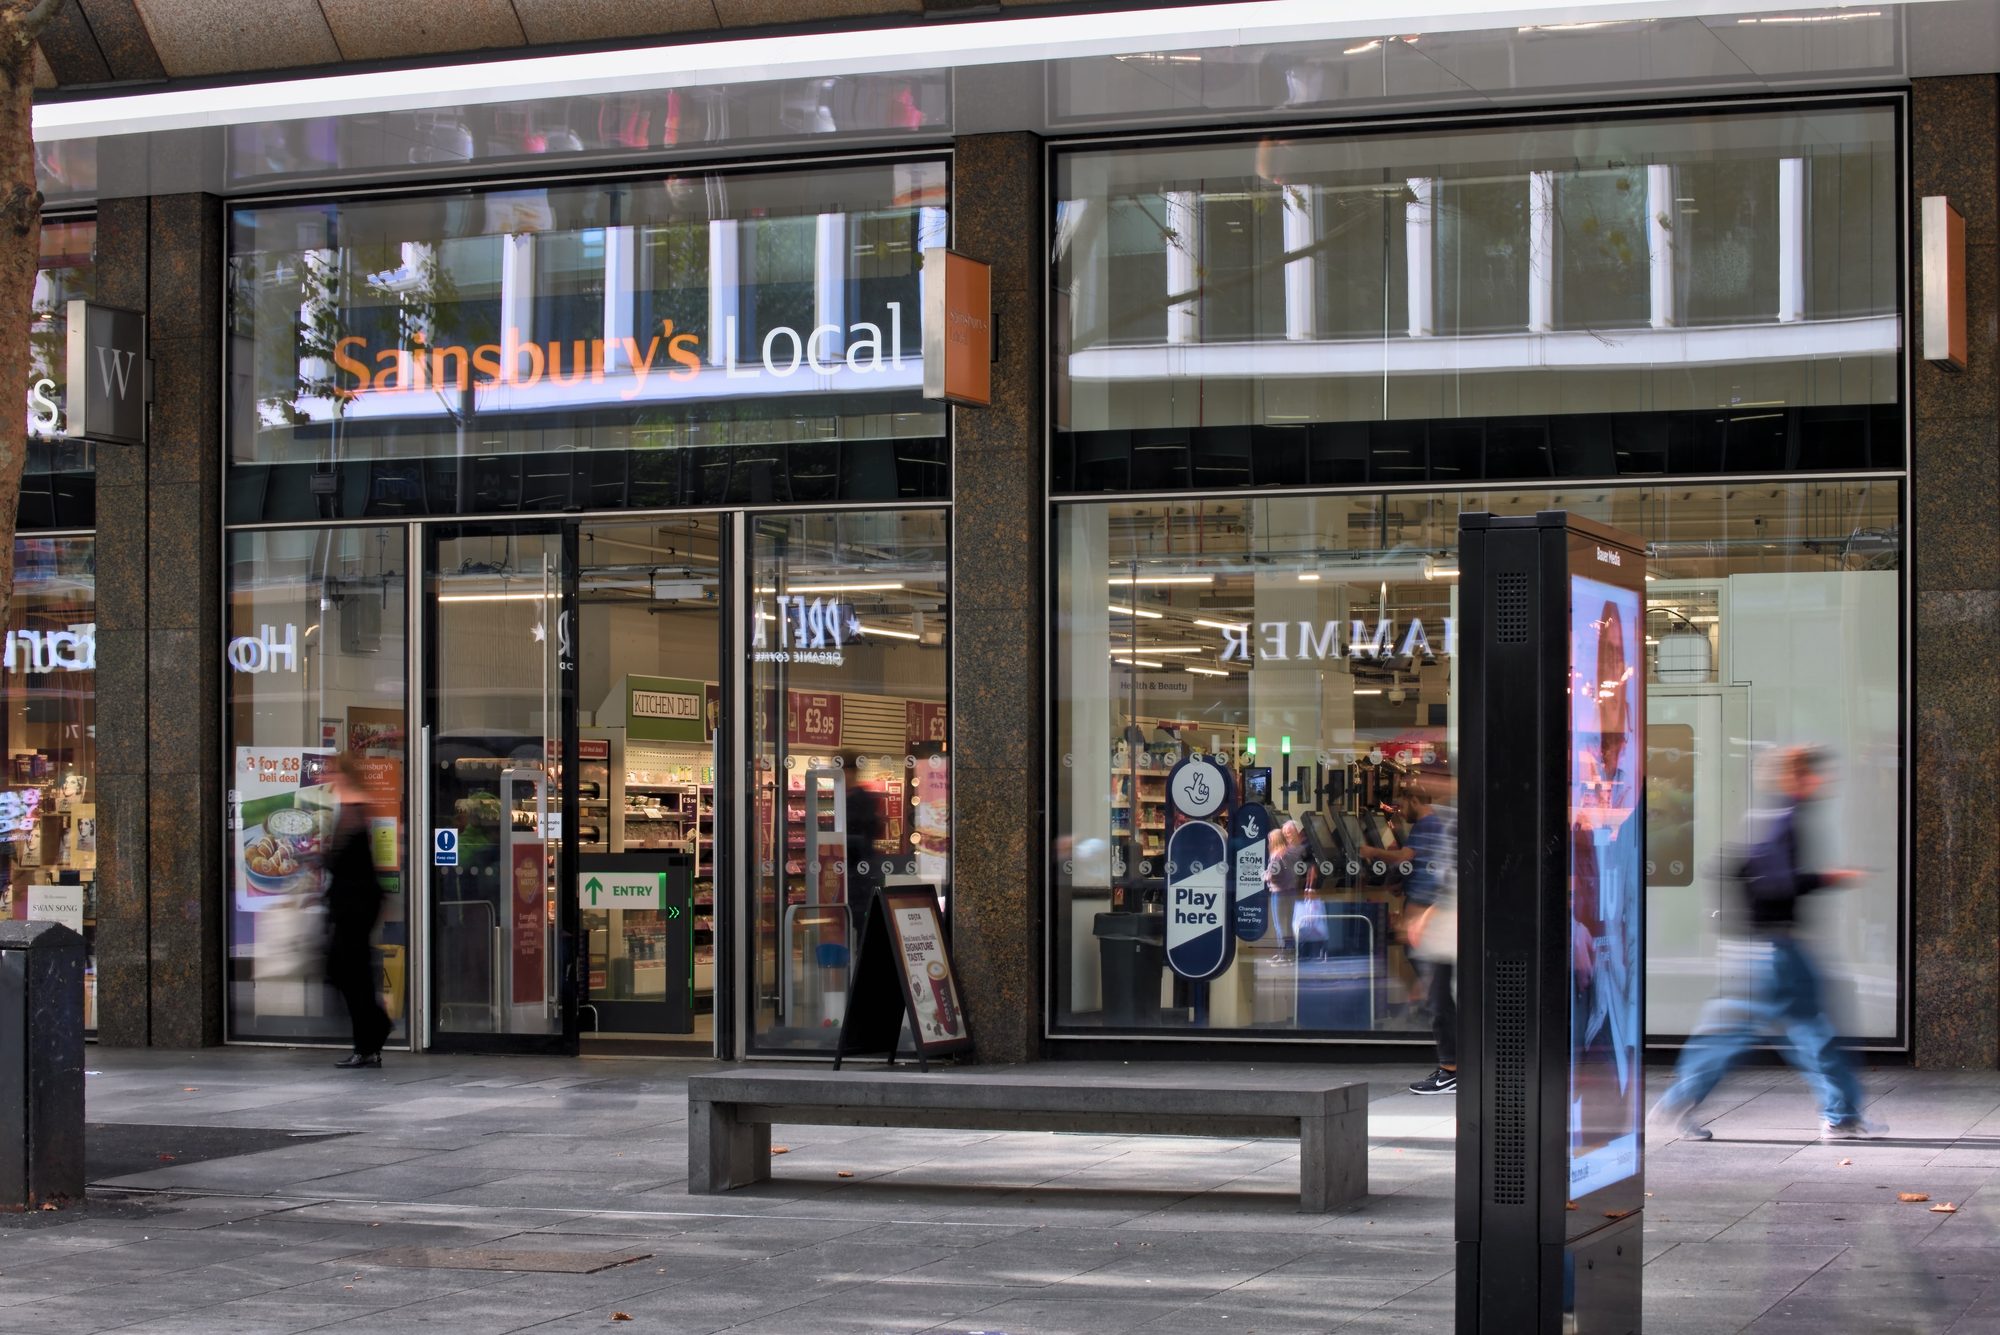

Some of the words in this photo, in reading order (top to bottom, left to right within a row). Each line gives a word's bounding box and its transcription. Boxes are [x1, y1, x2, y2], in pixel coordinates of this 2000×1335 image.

[334, 318, 701, 400] Sainsbury's
[726, 301, 906, 379] Local
[96, 345, 136, 401] W
[1120, 681, 1147, 691] Helth
[1149, 682, 1156, 690] &
[1158, 682, 1188, 692] Beauty
[634, 694, 674, 715] KITCHEN
[677, 697, 698, 717] DELI
[805, 708, 834, 735] £3.95
[259, 756, 278, 770] for
[282, 757, 299, 771] £8
[259, 773, 276, 783] Deli
[279, 773, 298, 783] deal
[612, 885, 653, 897] ENTRY
[1176, 889, 1217, 910] Play
[32, 904, 54, 912] SWAN
[55, 904, 78, 912] SONG
[1175, 908, 1217, 924] here
[905, 941, 935, 952] SIGNATURE
